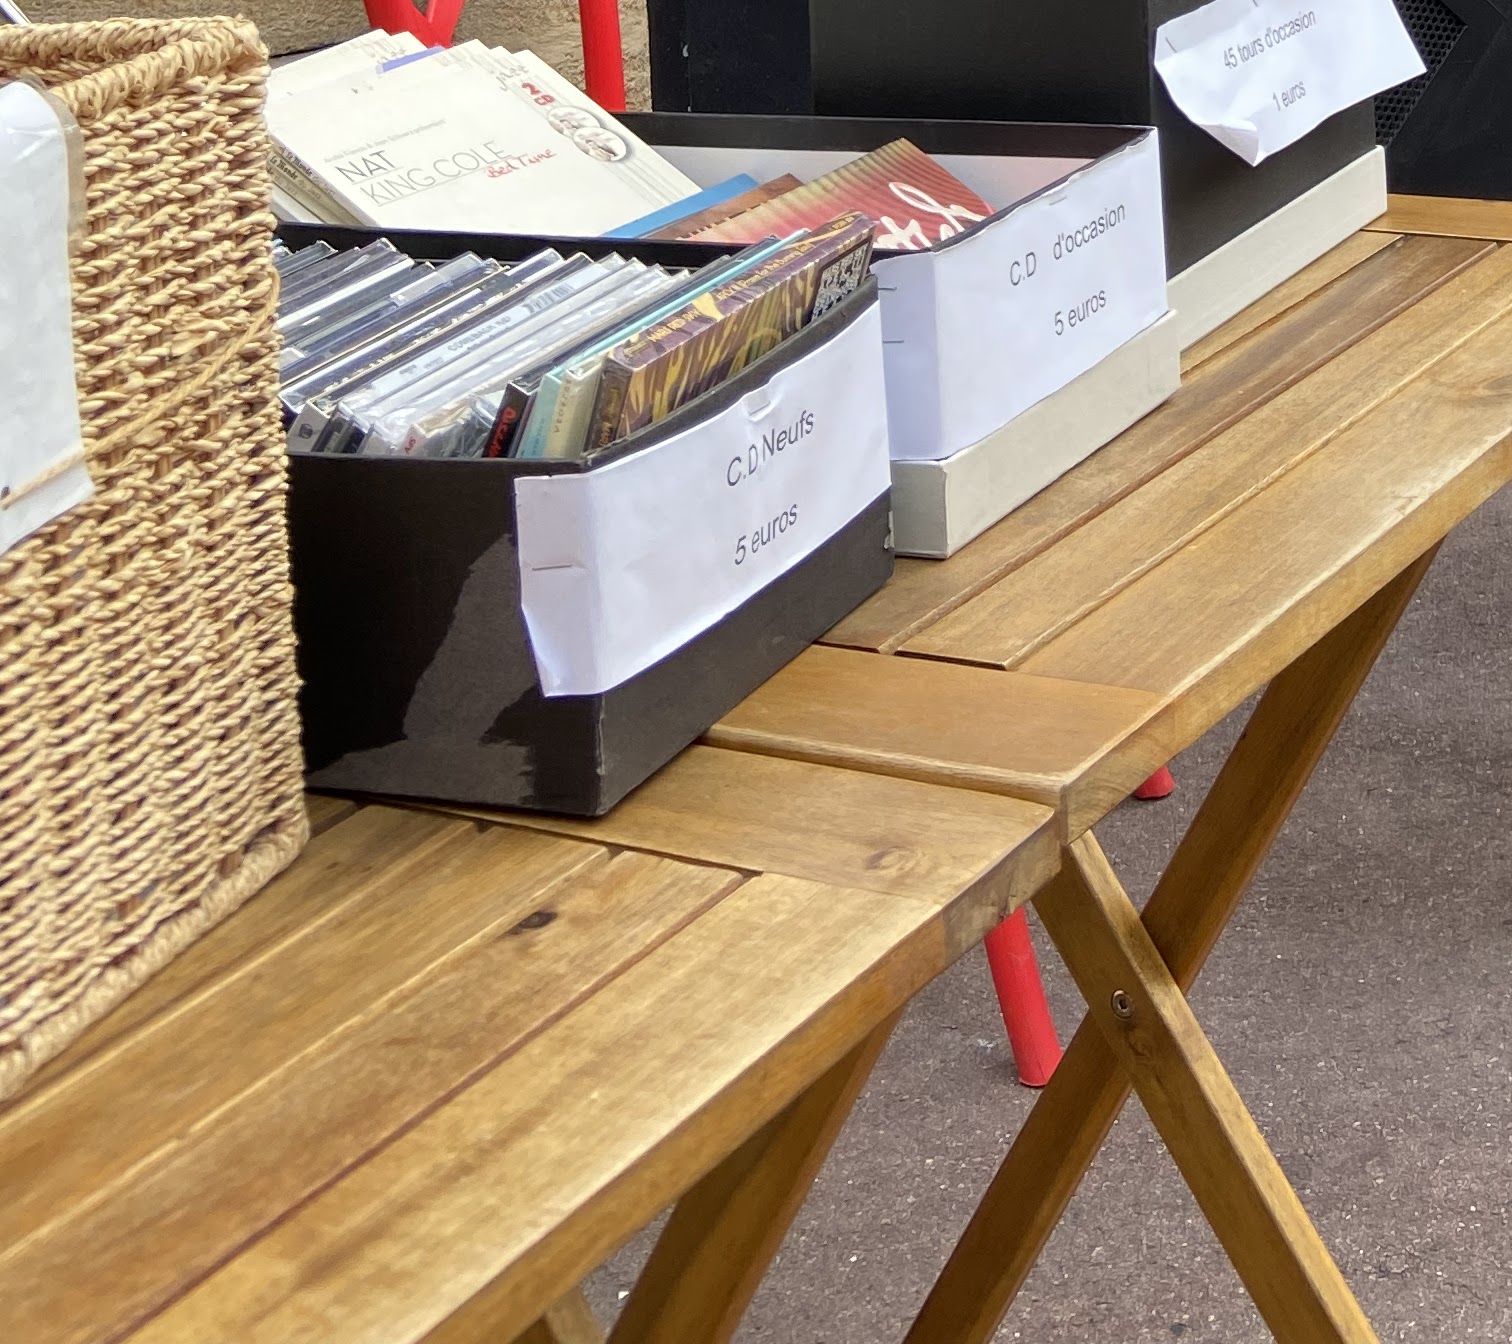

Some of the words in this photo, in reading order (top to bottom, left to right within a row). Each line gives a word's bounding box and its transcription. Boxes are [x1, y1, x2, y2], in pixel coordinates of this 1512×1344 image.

[1223, 49, 1239, 71] 45
[1239, 36, 1265, 63] tours
[1265, 8, 1316, 50] d'occasion
[522, 82, 540, 95] 2
[1272, 91, 1280, 112] 1
[1280, 78, 1307, 108] euros
[335, 150, 398, 183] NAT
[360, 166, 437, 204] KING
[433, 140, 513, 178] COLE
[1009, 249, 1038, 289] C.D
[1052, 201, 1127, 263] d'occasion
[1053, 310, 1064, 338] 5
[1068, 288, 1108, 330] euros
[761, 408, 815, 456] Neufs
[733, 535, 747, 568] 5
[751, 501, 799, 556] euros
